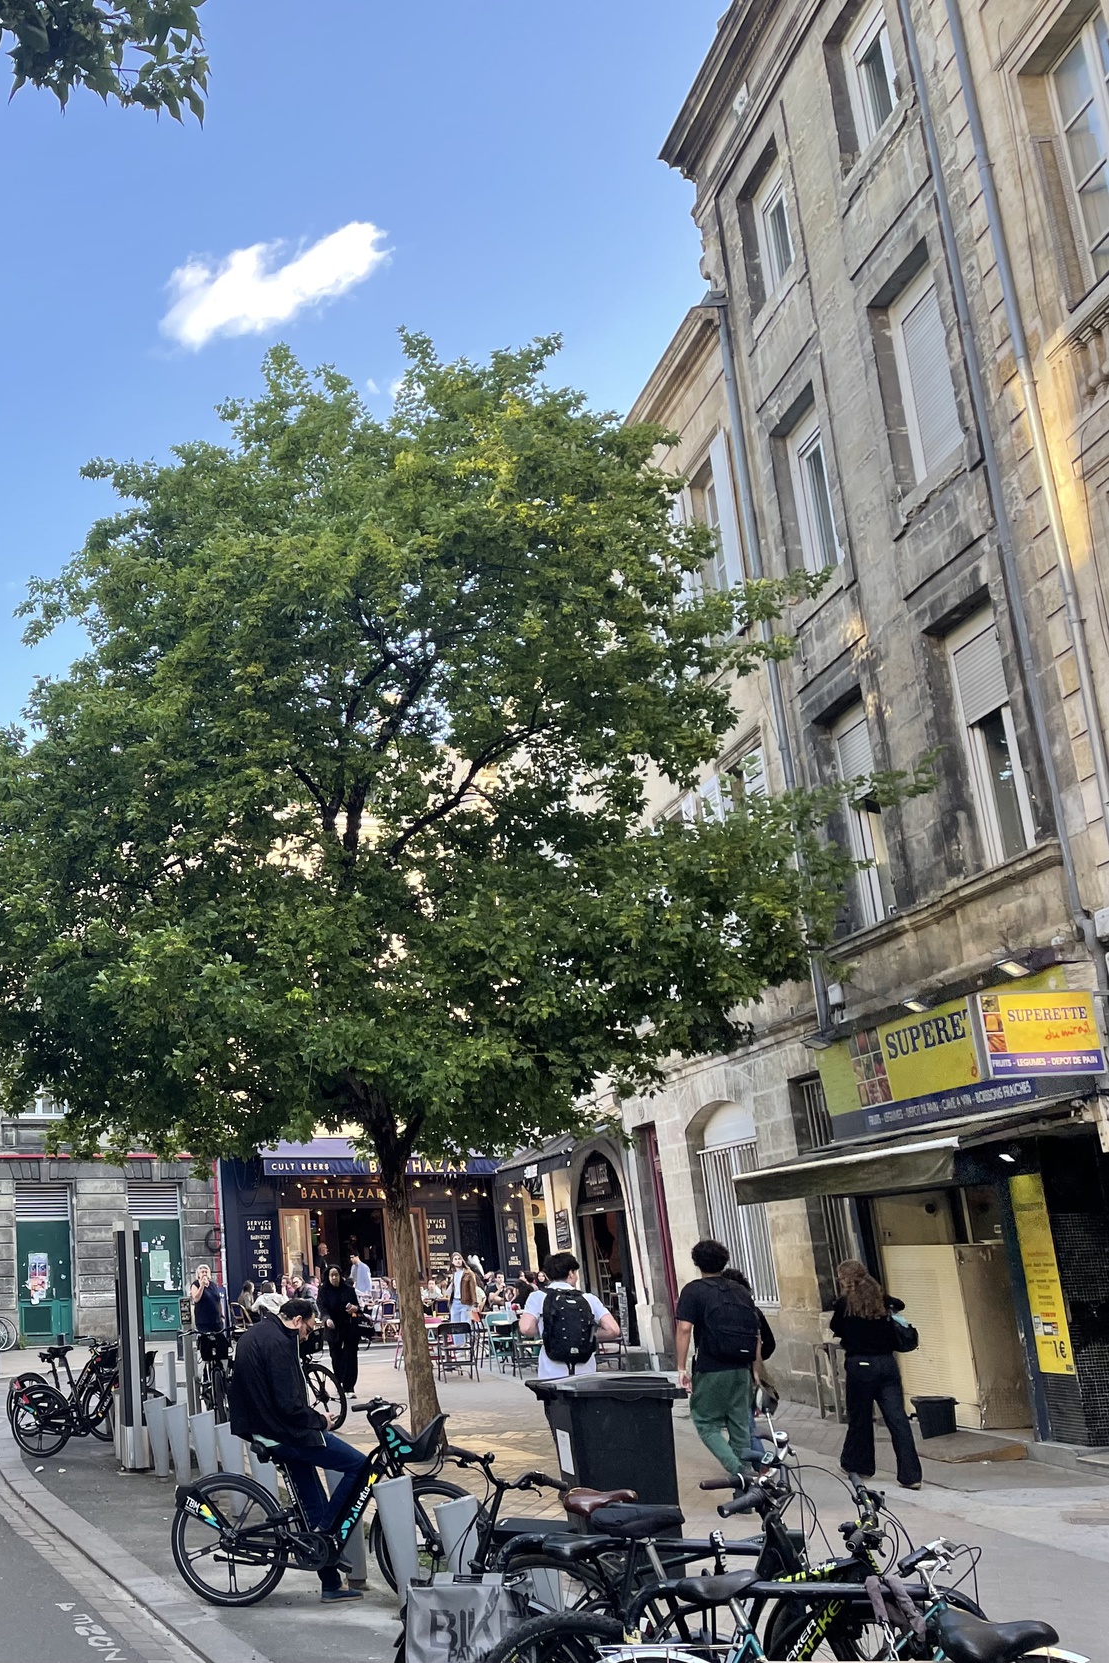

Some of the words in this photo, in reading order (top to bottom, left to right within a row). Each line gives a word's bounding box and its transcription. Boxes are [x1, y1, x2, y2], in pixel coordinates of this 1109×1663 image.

[1007, 1007, 1087, 1022] SUPERETTE
[1045, 1027, 1060, 1040] du
[992, 1059, 1012, 1067] FRUITS
[1017, 1058, 1046, 1067] LEGUMES
[1052, 1056, 1072, 1065] DEPOT
[1073, 1056, 1081, 1065] DE
[1083, 1055, 1098, 1064] PAIN
[271, 1162, 295, 1171] CULT
[301, 1162, 330, 1171] BEERS
[185, 1495, 202, 1512] TBM
